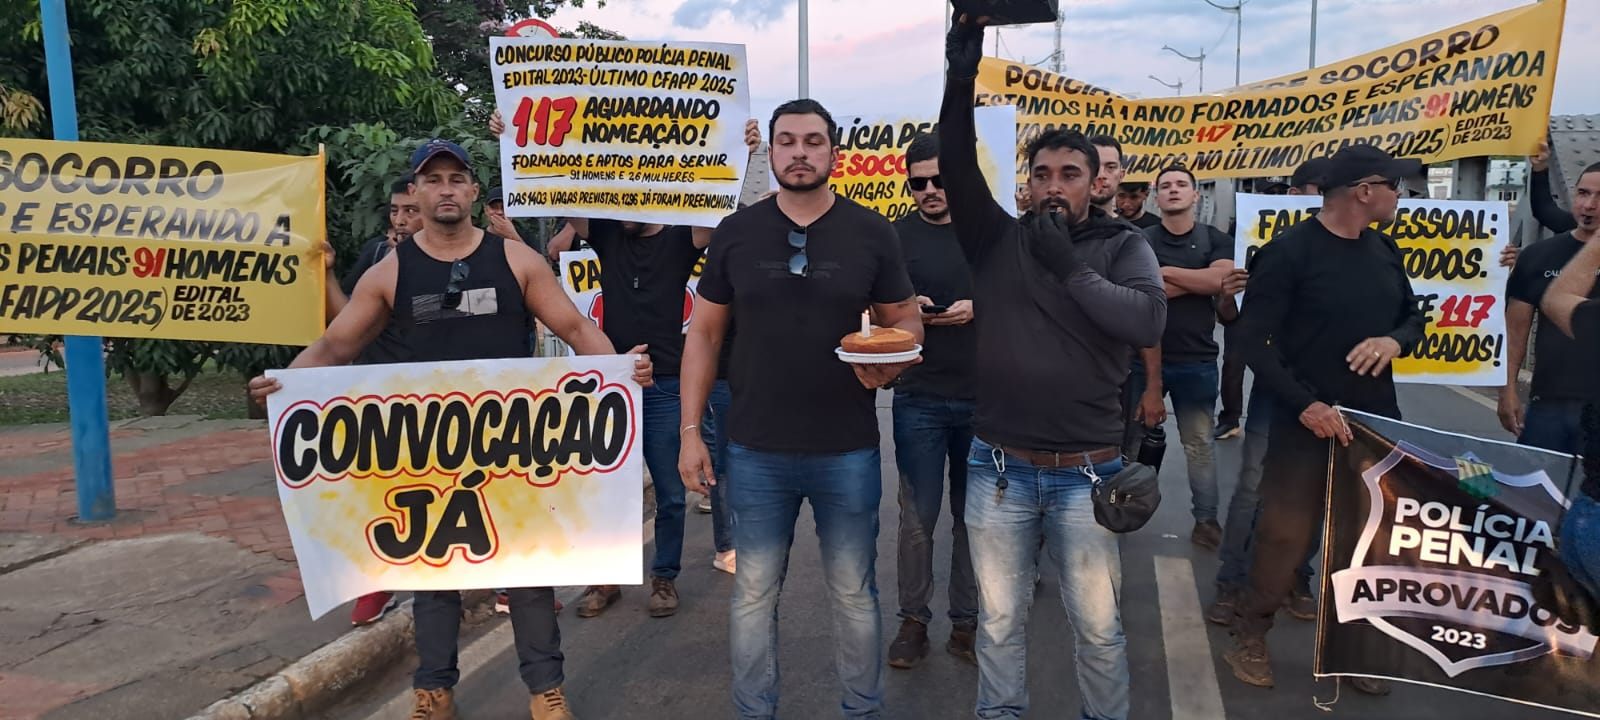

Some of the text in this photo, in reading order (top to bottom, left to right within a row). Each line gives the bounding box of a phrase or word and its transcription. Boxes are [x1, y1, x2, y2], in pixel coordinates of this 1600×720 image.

[495, 43, 732, 70] CONCURSO PÚBLICO POLÍCIA PENAL
[1320, 24, 1500, 83] SOCORRO
[503, 70, 551, 89] EDITAL
[589, 65, 648, 86] ÚLTIMO
[652, 72, 697, 91] CFAPP
[700, 74, 736, 95] 2025
[1085, 98, 1116, 119] HÁ
[1119, 105, 1129, 120] 1
[1133, 105, 1185, 123] ANO
[1190, 92, 1337, 124] FORMADOS
[1343, 89, 1360, 106] E
[1367, 51, 1528, 99] ESPERANDO
[1525, 50, 1545, 77] A
[512, 96, 578, 148] 117
[582, 96, 720, 121] AGUARDANDO
[1118, 125, 1194, 147] SOMOS
[1196, 123, 1233, 143] 117
[1232, 112, 1337, 141] POLICIAIS
[1449, 83, 1537, 117] HOMENS
[1455, 112, 1509, 132] EDITAL
[582, 119, 709, 149] NOMEAÇÃO!
[836, 117, 893, 151] LÍCIA
[1121, 152, 1188, 175] MADOS
[1190, 149, 1223, 171] NO
[1223, 142, 1304, 171] ÚLTIMO
[1385, 124, 1451, 158] 2025)
[1451, 125, 1512, 146] DE 2023
[0, 149, 224, 200] SOCORRO
[512, 154, 728, 171] FORMADOS E APTOS PARA SERVIR
[570, 170, 695, 183] 91 HOMENS E 26 MULHERES
[507, 192, 528, 207] DAS
[550, 192, 578, 205] VAGAS
[579, 191, 621, 208] PREVISTAS,
[640, 188, 652, 206] JÁ
[653, 192, 681, 207] FORAM
[844, 180, 895, 201] VAGAS
[10, 202, 40, 233] E
[47, 202, 260, 243] ESPERANDO
[264, 215, 291, 247] A
[1379, 207, 1498, 240] ESSOAL:
[132, 246, 166, 278] 91
[164, 248, 299, 285] HOMENS
[0, 284, 168, 330] FAPP 2025)
[173, 285, 245, 302] EDITAL
[171, 304, 250, 322] DE 2023
[1436, 294, 1496, 328] 117
[1413, 333, 1504, 367] OCADOS!
[279, 377, 628, 482] CONVOCAÇÃO
[373, 470, 491, 559] JÁ
[1395, 497, 1555, 549] POLÍCIA
[1389, 525, 1542, 576] PENAL
[1431, 625, 1486, 649] 2023
